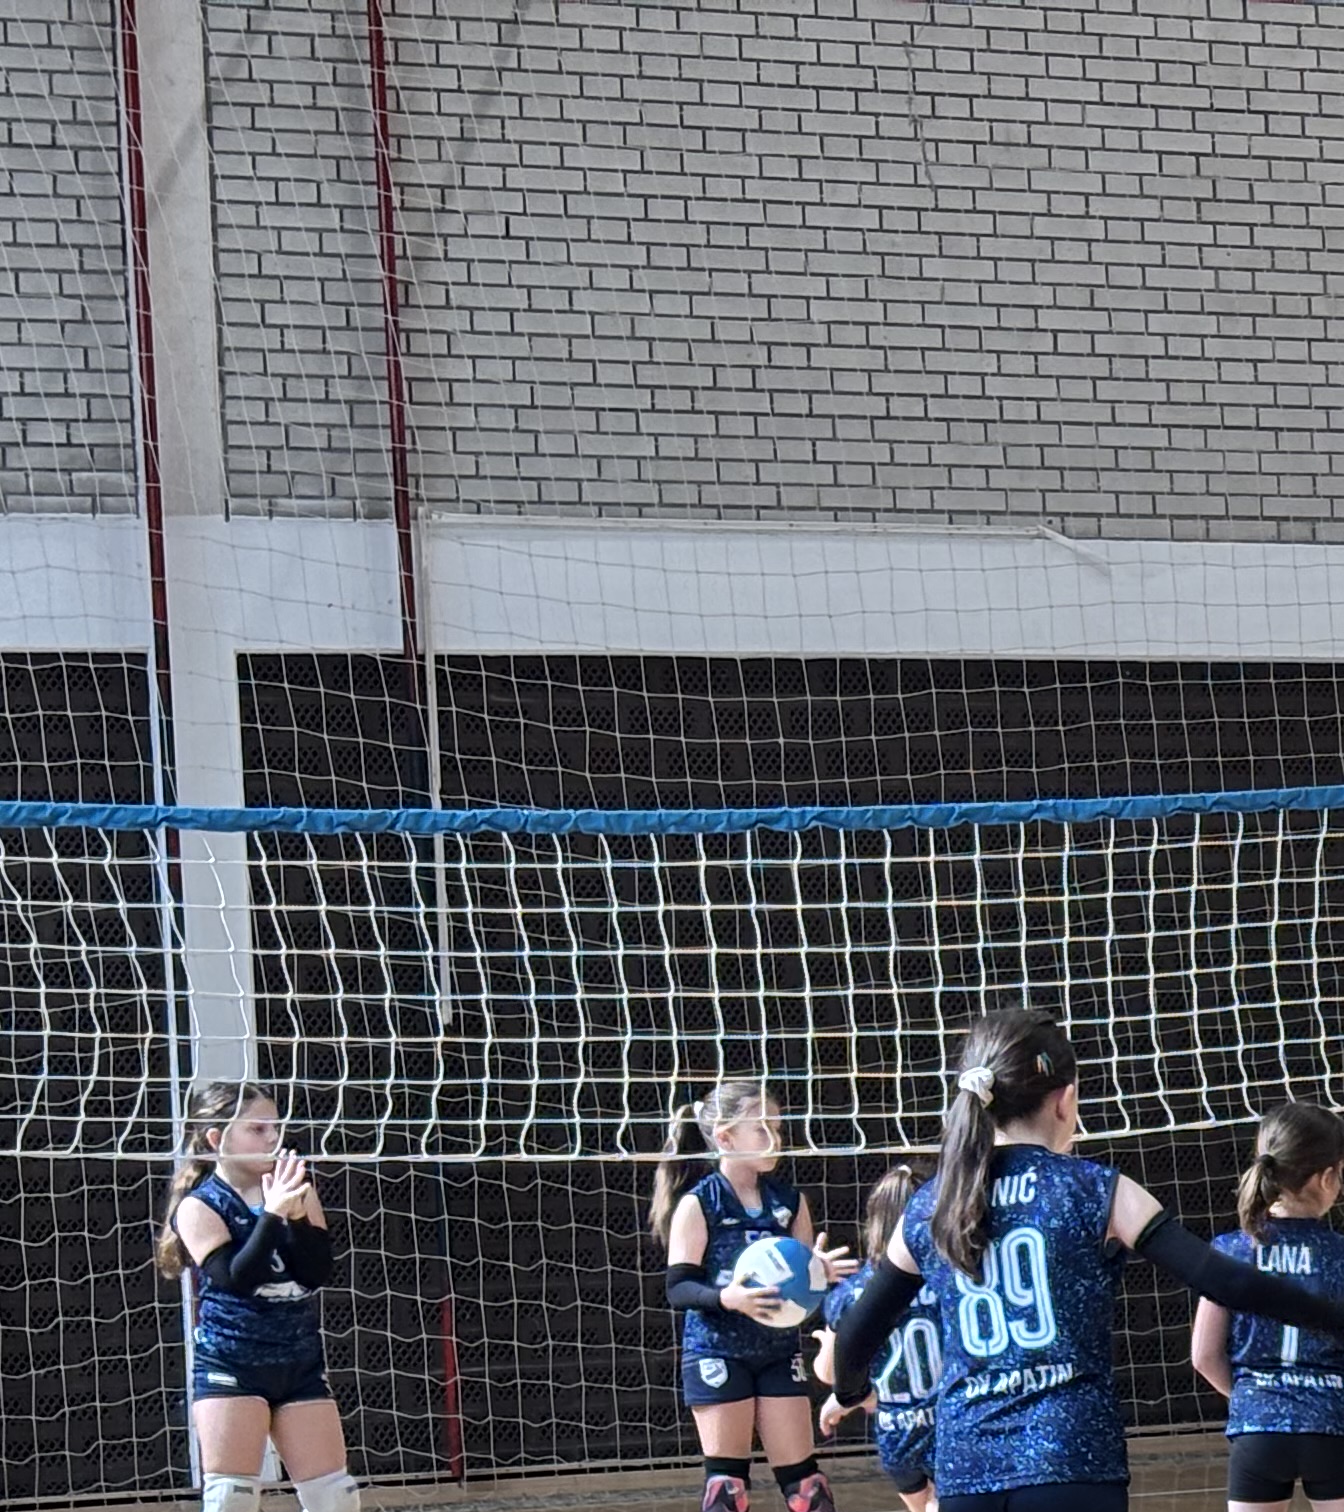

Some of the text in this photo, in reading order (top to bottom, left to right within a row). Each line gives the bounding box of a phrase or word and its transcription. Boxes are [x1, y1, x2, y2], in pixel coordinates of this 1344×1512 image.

[955, 1226, 1056, 1358] 89
[1256, 1243, 1312, 1275] LANA
[876, 1317, 944, 1404] 20
